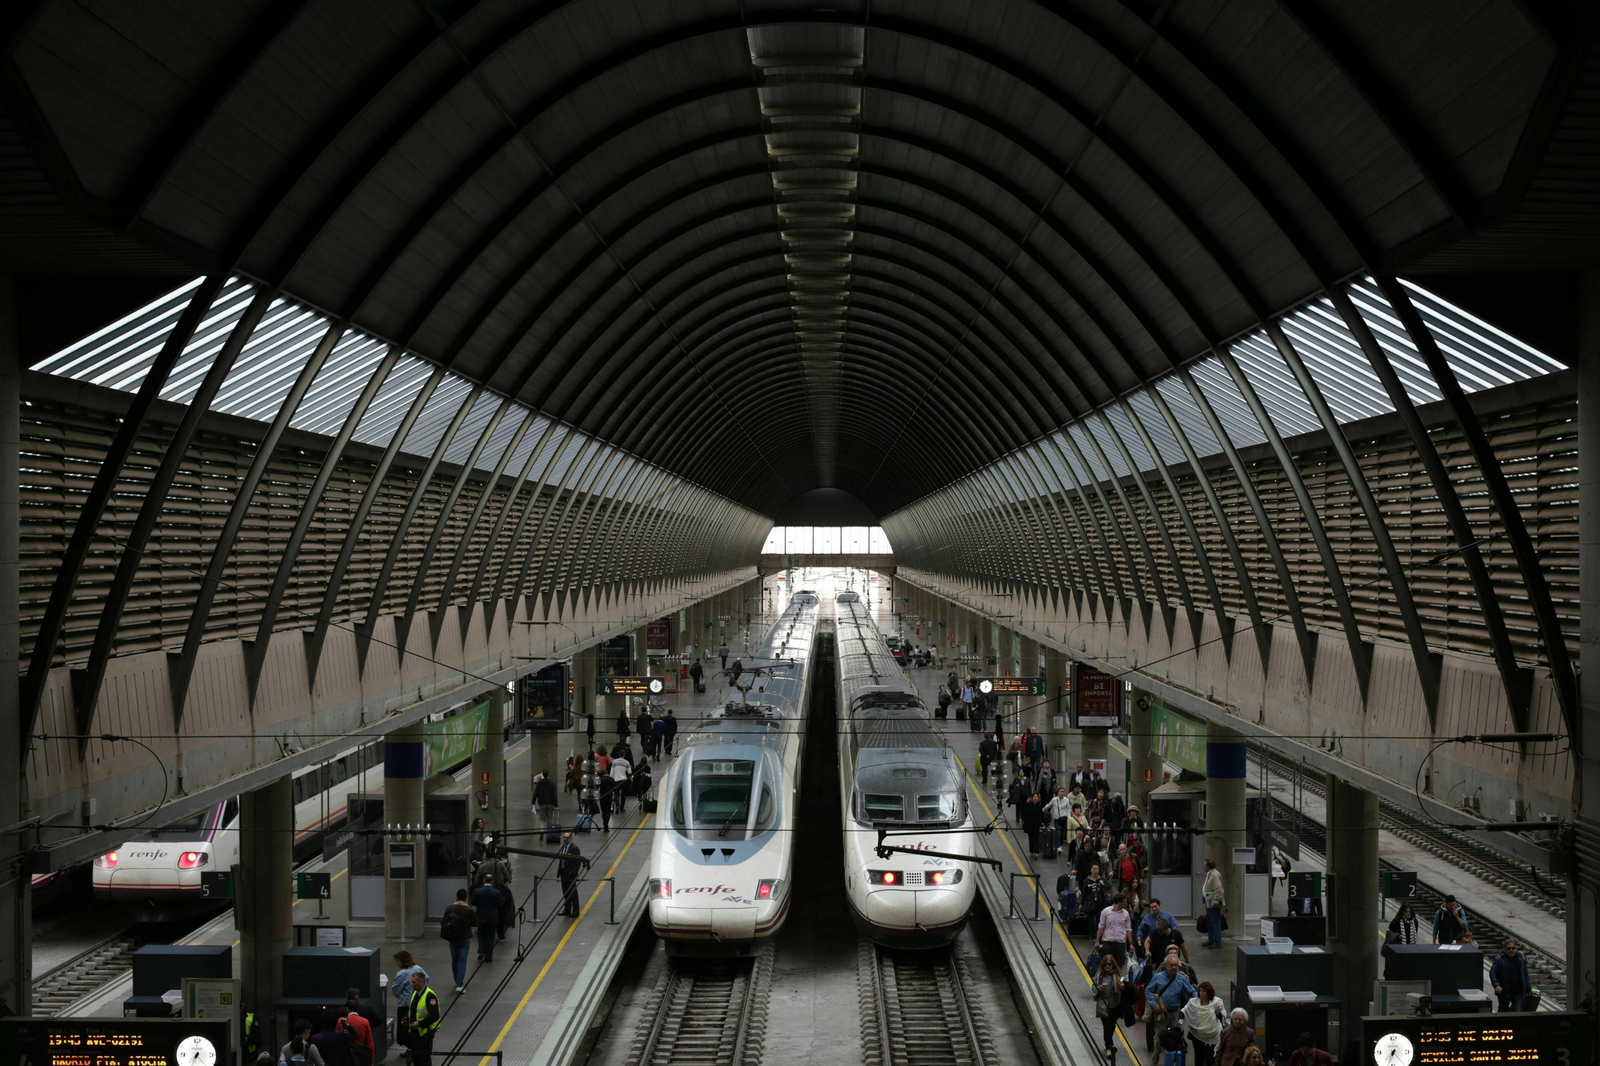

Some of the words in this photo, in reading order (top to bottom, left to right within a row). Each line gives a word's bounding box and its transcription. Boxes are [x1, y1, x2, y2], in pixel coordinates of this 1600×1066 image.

[130, 848, 168, 860] renfe
[922, 857, 954, 866] AVE
[202, 884, 210, 896] 5
[320, 886, 328, 898] 4
[674, 884, 736, 896] renfe
[1290, 885, 1297, 897] 3
[1408, 884, 1416, 897] 2
[722, 895, 752, 905] AVE
[48, 1034, 81, 1046] 19:45
[1420, 1031, 1452, 1042] 19:35
[1457, 1030, 1476, 1041] AVE
[1482, 1029, 1514, 1041] 02170
[52, 1055, 91, 1066] MADRID
[96, 1055, 120, 1066] PTA.
[128, 1055, 167, 1066] ATOCHA
[1420, 1051, 1464, 1063] SEVILLA
[1470, 1050, 1502, 1062] SANTA
[1506, 1049, 1539, 1060] JUSTA
[1556, 1046, 1570, 1066] 3
